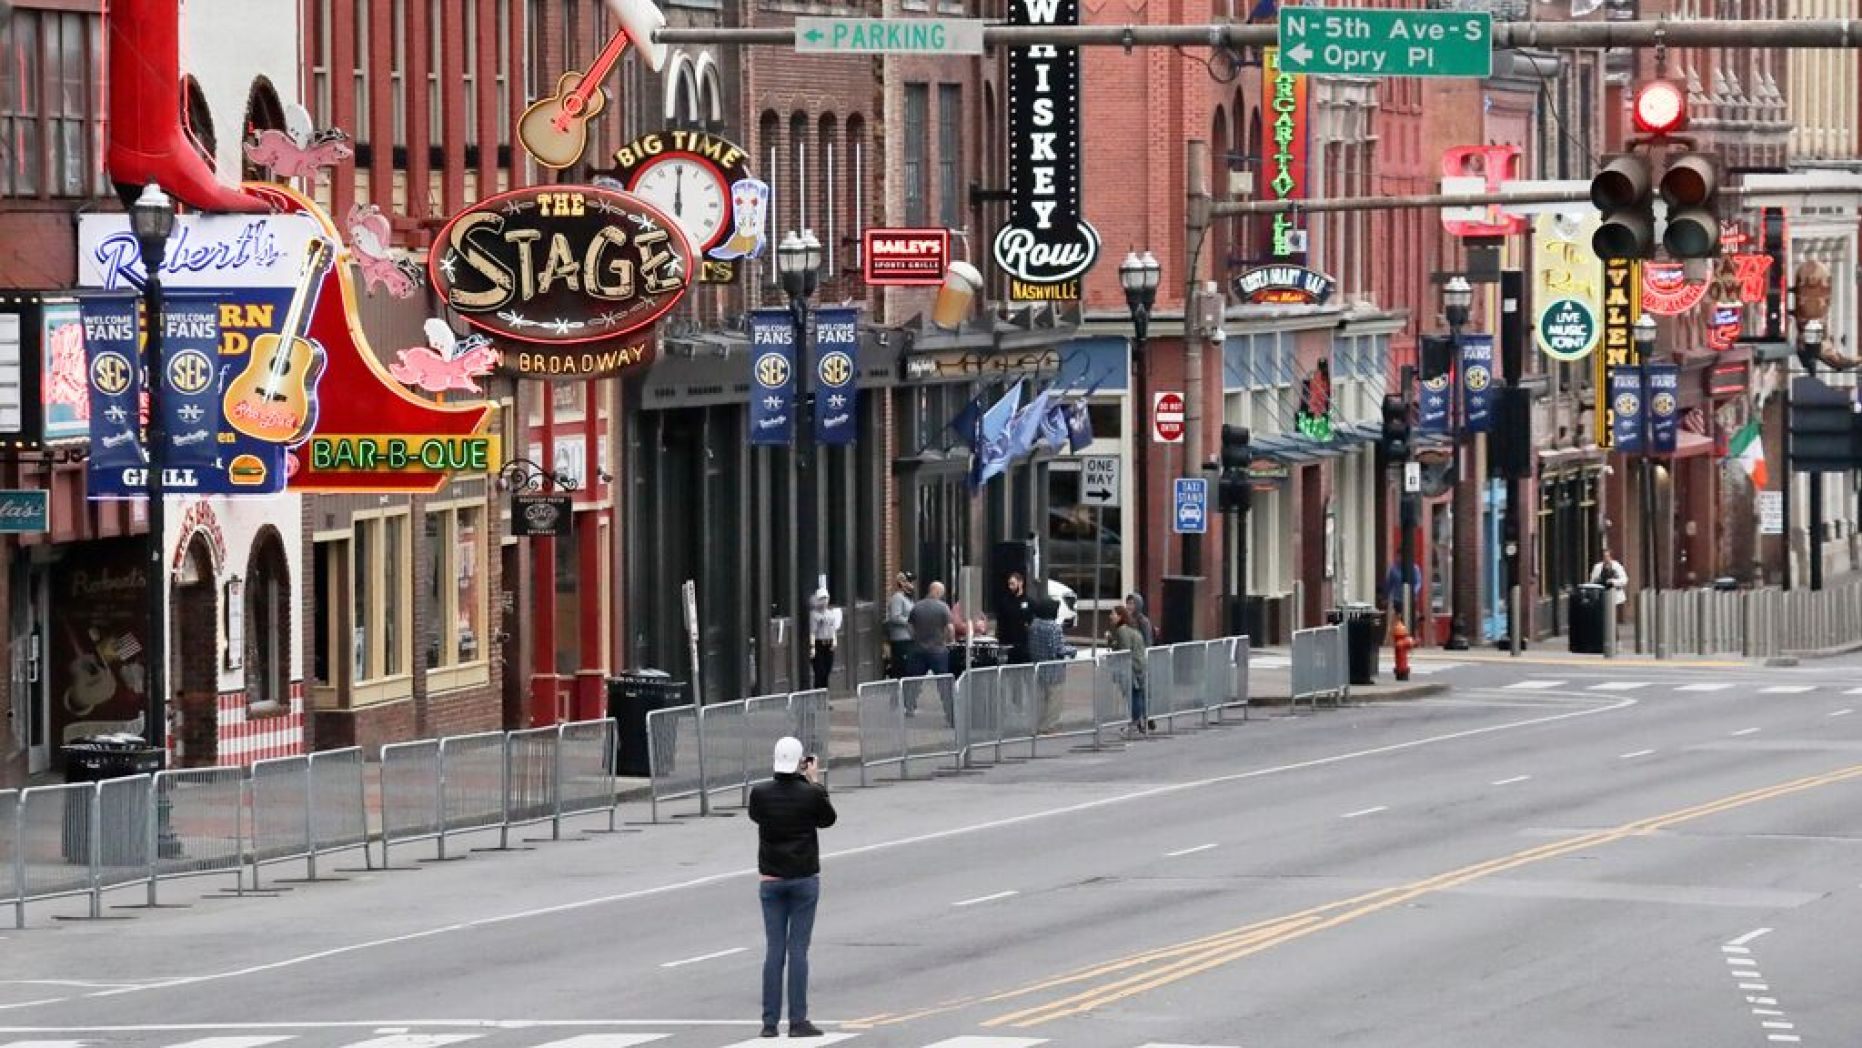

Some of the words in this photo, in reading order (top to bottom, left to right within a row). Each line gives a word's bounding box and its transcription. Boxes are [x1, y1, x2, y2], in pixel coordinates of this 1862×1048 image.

[833, 23, 946, 49] PARKING
[1287, 16, 1370, 38] N-5th
[1390, 19, 1482, 41] Ave-S
[1323, 45, 1387, 70] Opry
[1407, 47, 1434, 68] Pl
[616, 134, 664, 168] BIG
[671, 131, 746, 168] TIME
[1271, 54, 1296, 255] ARGARITAVLLE
[537, 193, 585, 216] THE
[94, 219, 281, 290] Rbert's
[872, 239, 941, 254] BAILEY'S
[1002, 228, 1087, 272] Row
[449, 211, 684, 311] STAGE
[1012, 280, 1078, 300] NASHVILLE
[84, 314, 132, 325] WELCOME
[166, 312, 216, 323] WELCOME
[754, 324, 792, 333] WELCOME
[816, 323, 854, 332] WELCOME
[1556, 312, 1582, 323] LIVE
[85, 324, 134, 341] FANS
[166, 322, 217, 339] FANS
[754, 332, 793, 345] FANS
[816, 331, 855, 343] FANS
[519, 344, 645, 374] BROADWAY
[759, 356, 786, 386] SEC
[823, 355, 849, 385] SEC
[95, 354, 127, 391] SEC
[173, 354, 208, 391] SEC
[313, 440, 489, 469] BAR-B-QUE
[1087, 459, 1114, 471] ONE
[1086, 474, 1115, 485] WAY
